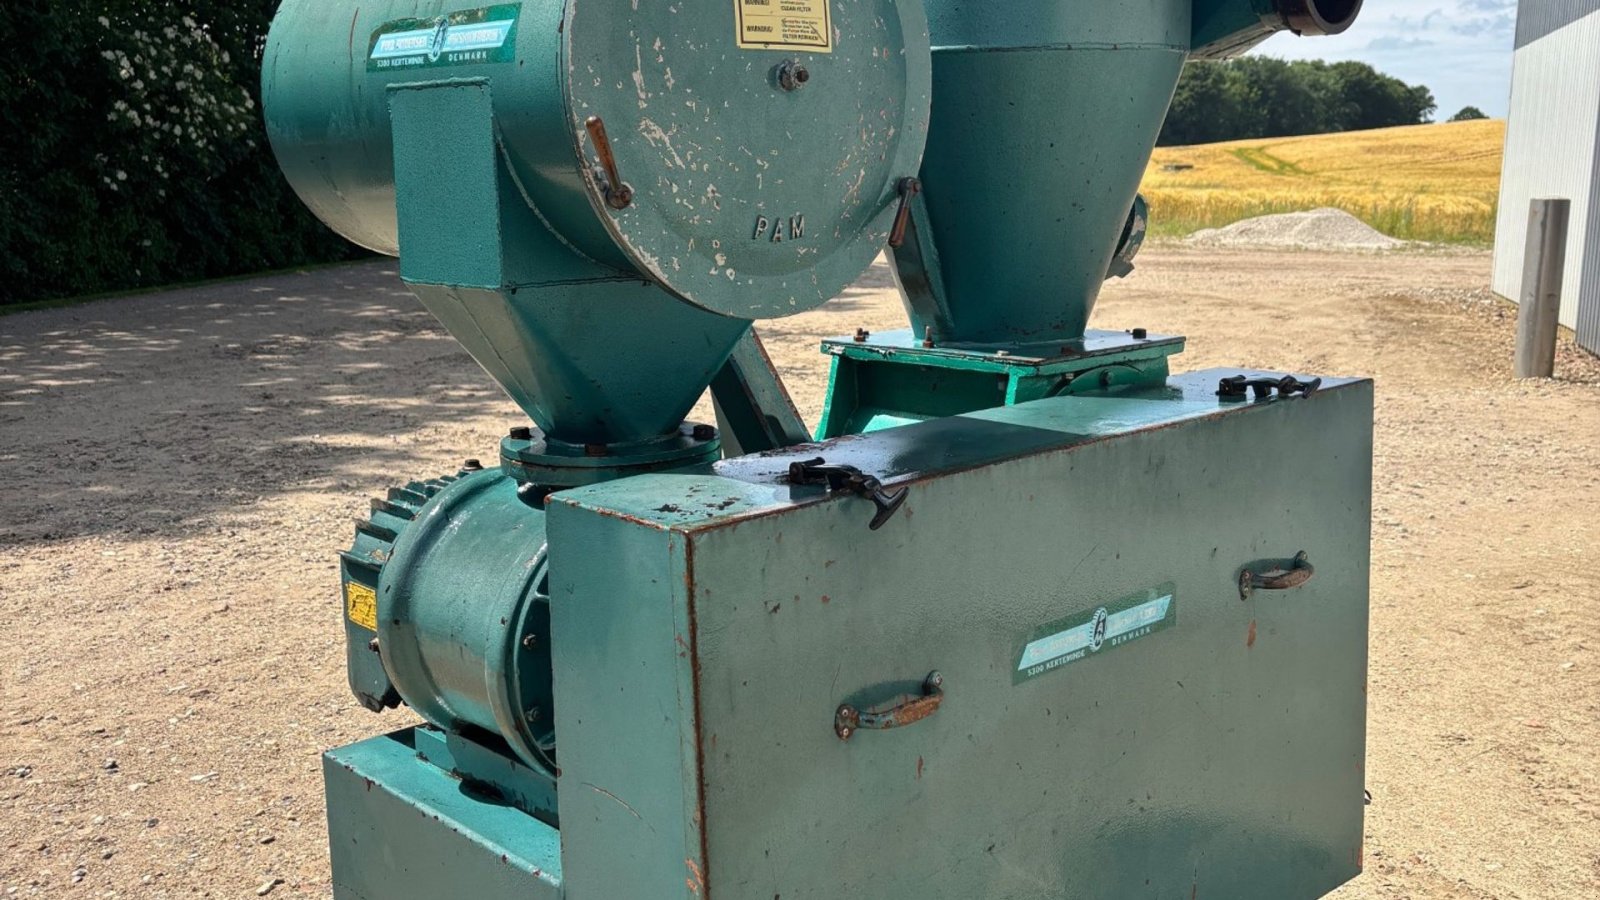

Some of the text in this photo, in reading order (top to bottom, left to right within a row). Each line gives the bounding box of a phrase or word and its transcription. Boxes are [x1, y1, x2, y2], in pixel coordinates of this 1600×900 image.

[448, 51, 487, 62] DENMARK
[752, 214, 805, 244] PAM
[1028, 664, 1044, 676] 5300
[1112, 627, 1151, 646] DENMARK
